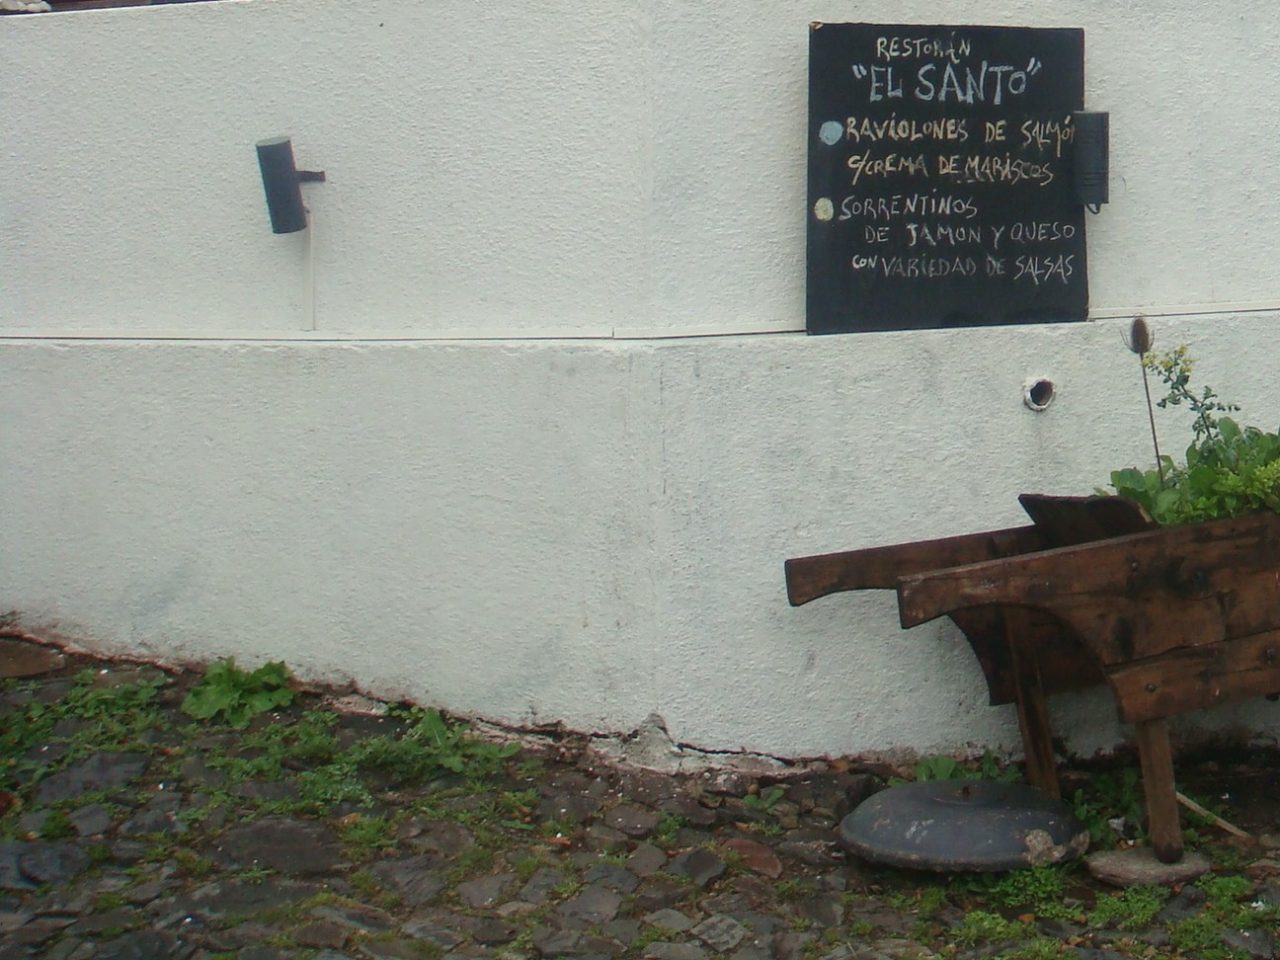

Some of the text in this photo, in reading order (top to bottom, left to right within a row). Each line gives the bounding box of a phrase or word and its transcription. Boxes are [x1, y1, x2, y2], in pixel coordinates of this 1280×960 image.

[985, 120, 1007, 143] DE
[938, 155, 960, 175] DE
[865, 226, 889, 244] DE
[991, 226, 1007, 250] Y
[1010, 222, 1076, 242] QUESO
[986, 253, 1007, 276] DE
[1014, 253, 1076, 286] SALSAS
